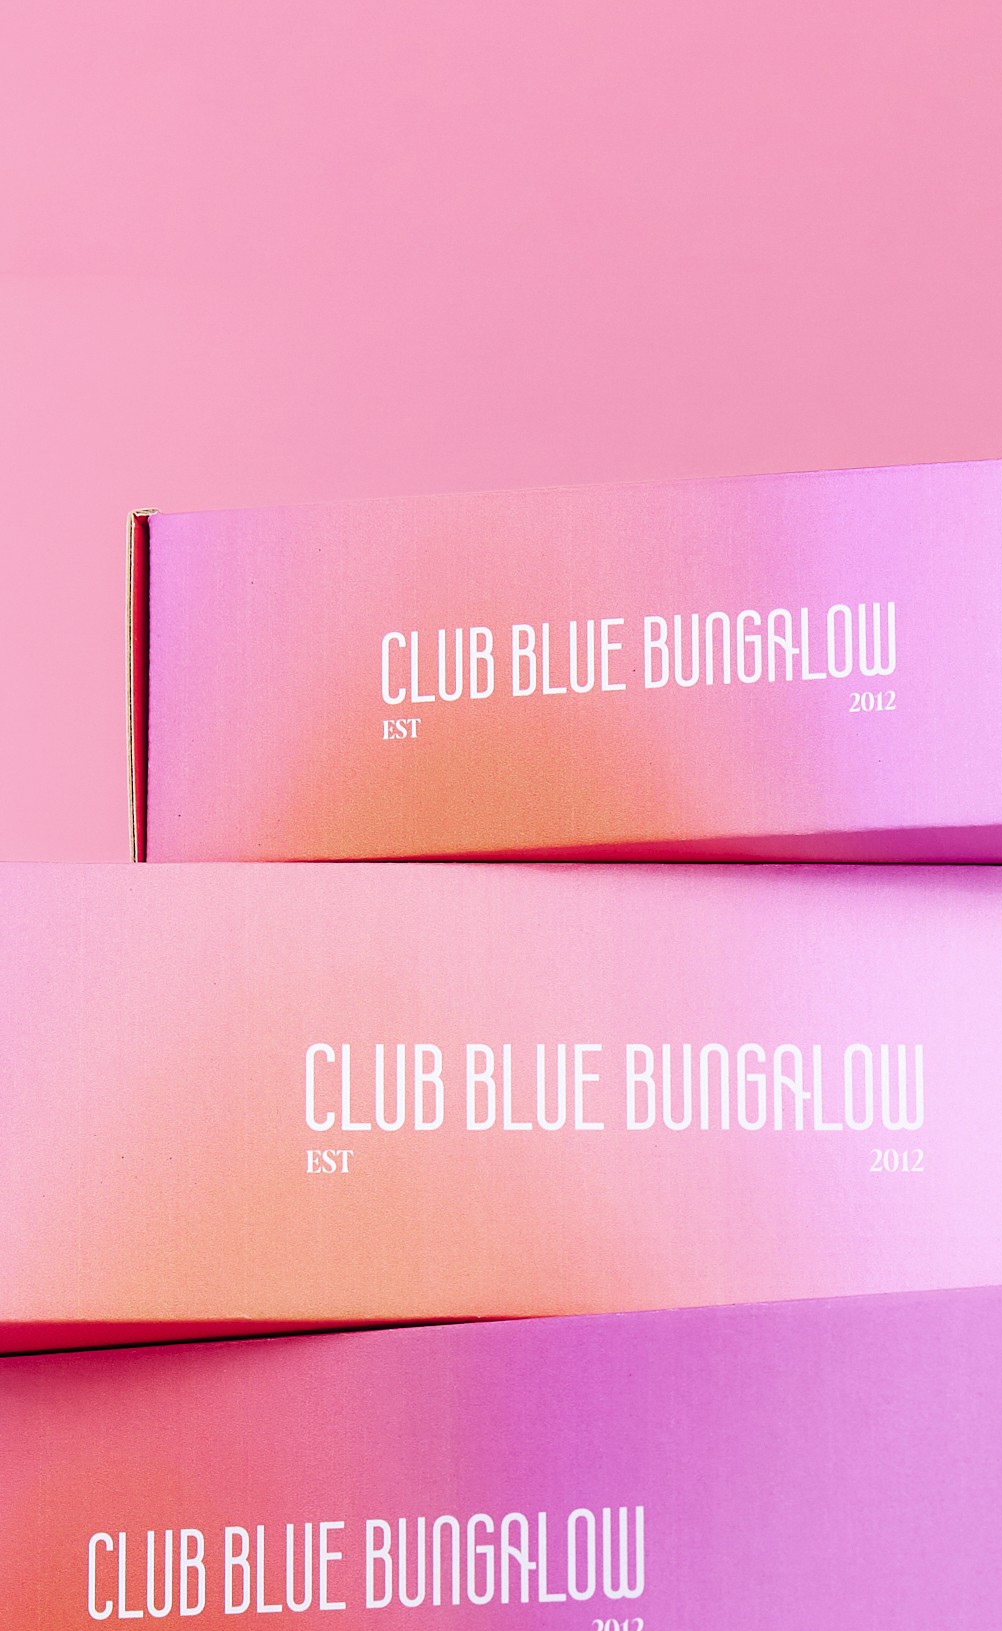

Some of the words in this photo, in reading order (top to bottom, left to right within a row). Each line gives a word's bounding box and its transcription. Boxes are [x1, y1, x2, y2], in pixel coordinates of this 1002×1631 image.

[382, 626, 495, 705] CLUB
[511, 618, 626, 697] BLUE
[643, 601, 897, 688] BUNGALOW
[382, 718, 421, 740] EST
[848, 689, 897, 713] 2012
[305, 1042, 445, 1132] CLUB
[465, 1043, 604, 1132] BLUE
[625, 1042, 924, 1132] BUNGALOW
[305, 1149, 354, 1174] EST
[869, 1149, 924, 1173] 2012
[87, 1527, 206, 1620] CLUB
[224, 1520, 346, 1615] BLUE
[365, 1505, 645, 1609] BUNGALOW
